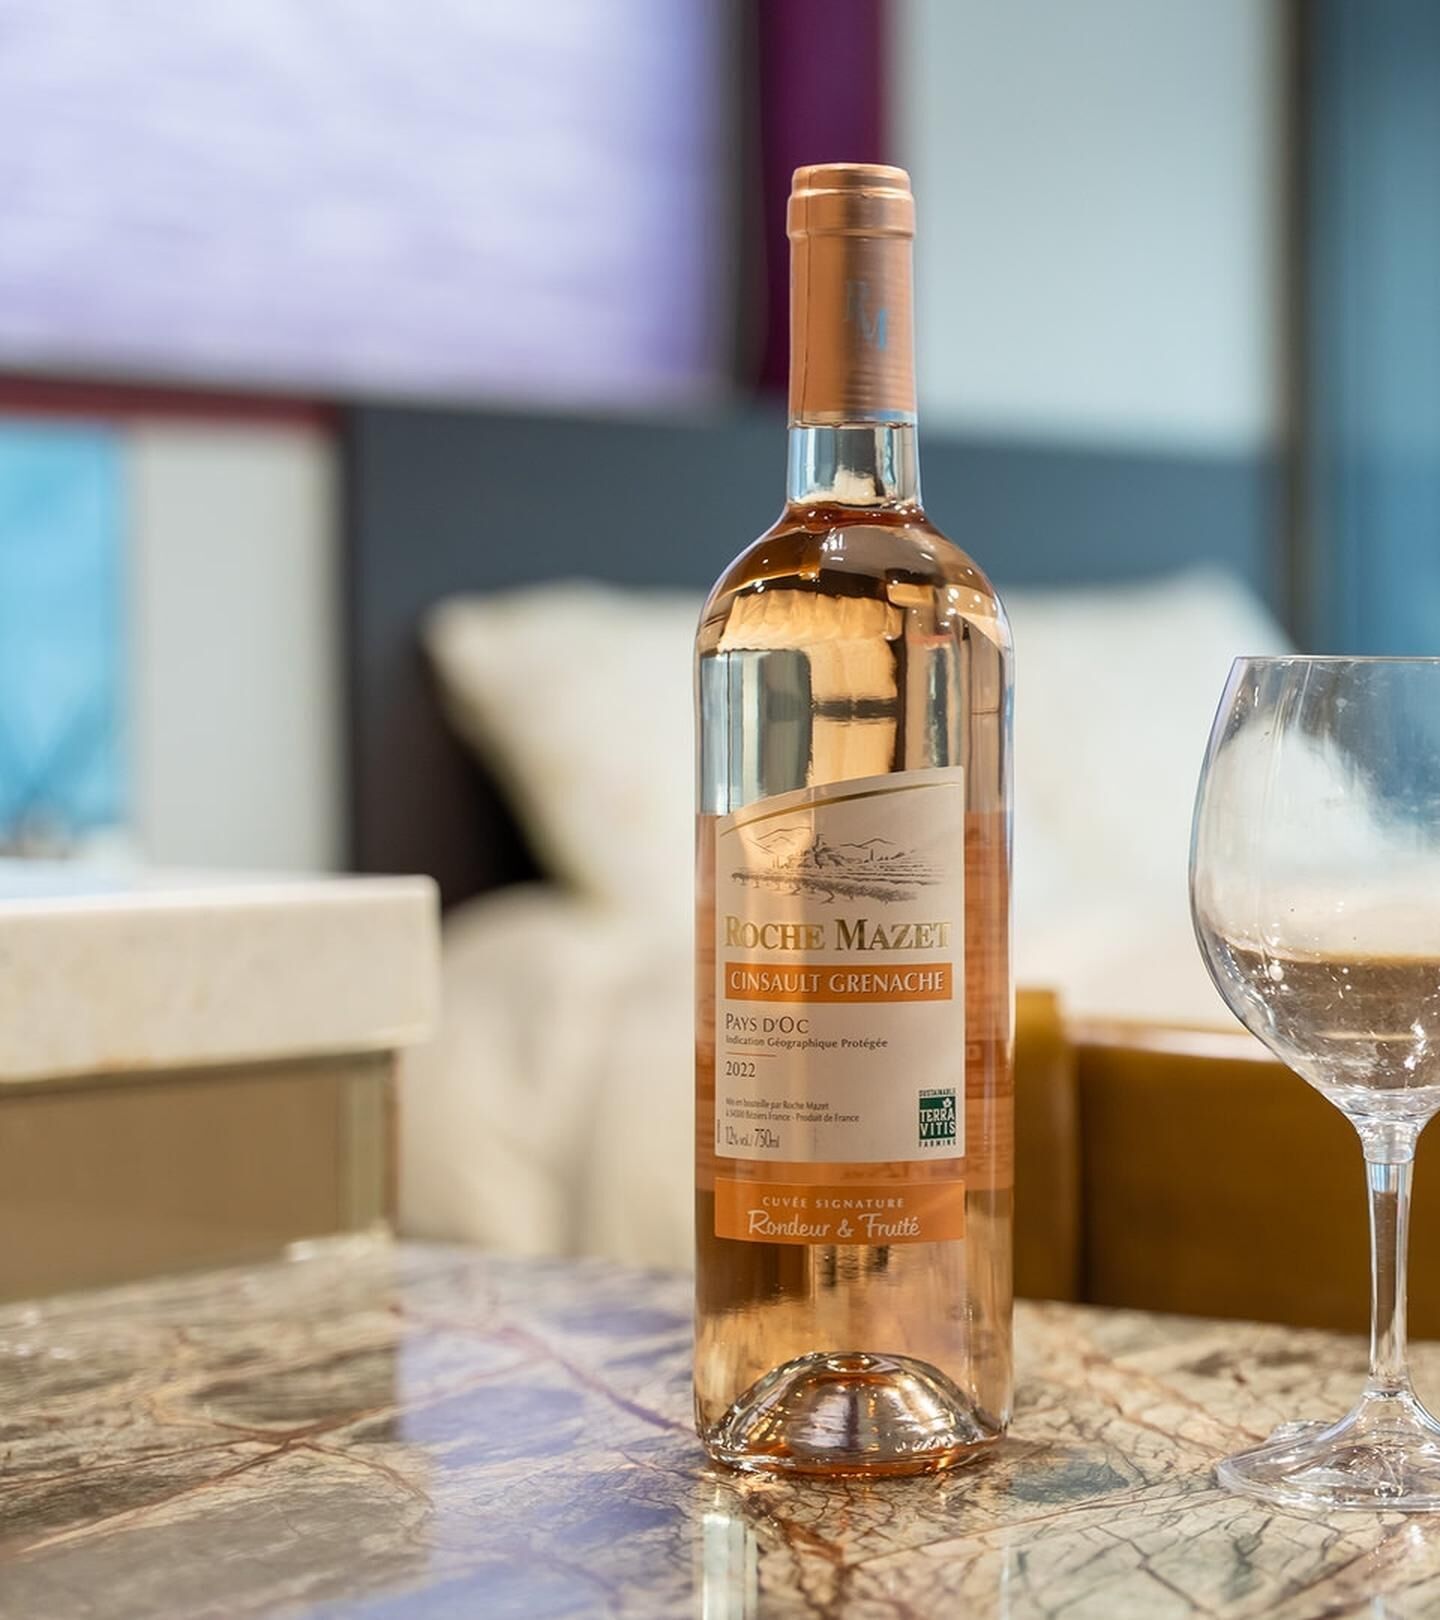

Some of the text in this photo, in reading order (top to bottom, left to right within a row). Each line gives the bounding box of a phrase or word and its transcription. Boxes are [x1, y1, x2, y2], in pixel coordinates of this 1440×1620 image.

[724, 916, 951, 951] ROCHE MAZET
[730, 970, 945, 993] CINSAULT GRENACHE
[725, 1012, 757, 1032] PAYS
[725, 1034, 888, 1050] Indication Géographique Protégée
[725, 1060, 756, 1078] 2022
[783, 1100, 805, 1110] Roche
[806, 1101, 829, 1111] Mazet
[823, 1113, 833, 1122] de
[834, 1113, 860, 1123] France
[920, 1108, 955, 1122] TERRA
[920, 1121, 956, 1136] VITIS
[762, 1196, 904, 1209] CUVÉE SIGNATURE
[747, 1210, 921, 1238] Rondeur & Fruité
